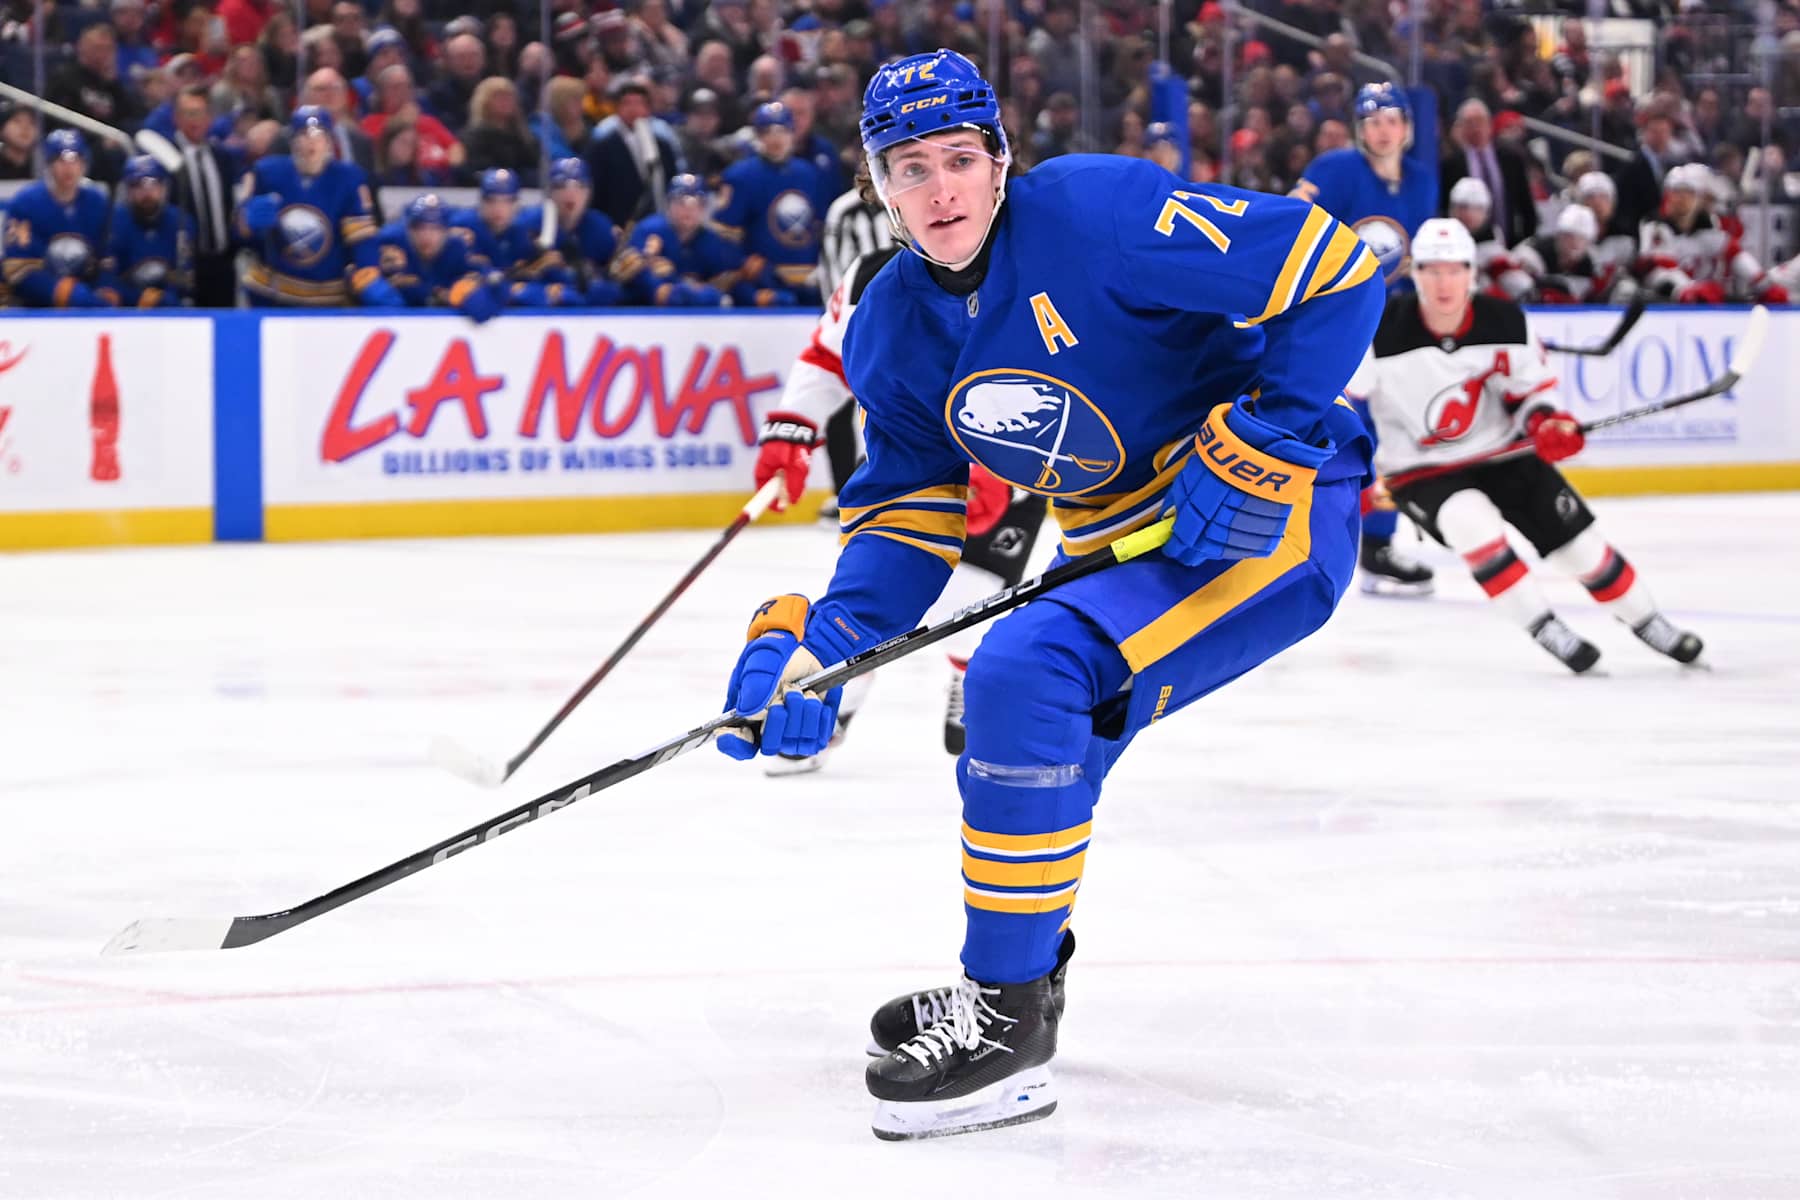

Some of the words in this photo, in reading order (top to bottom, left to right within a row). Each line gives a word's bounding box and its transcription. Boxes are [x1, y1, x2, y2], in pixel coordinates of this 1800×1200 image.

[901, 94, 948, 114] CCM
[1154, 190, 1250, 254] 72
[1029, 291, 1079, 355] A
[1493, 349, 1511, 377] A
[320, 328, 504, 464] LA
[519, 330, 782, 446] NOVA
[758, 421, 814, 444] UER
[383, 449, 510, 475] BILLIONS
[520, 448, 551, 472] OF
[561, 446, 655, 470] WINGS
[666, 444, 732, 467] SOLD
[875, 634, 909, 654] THOMPSON
